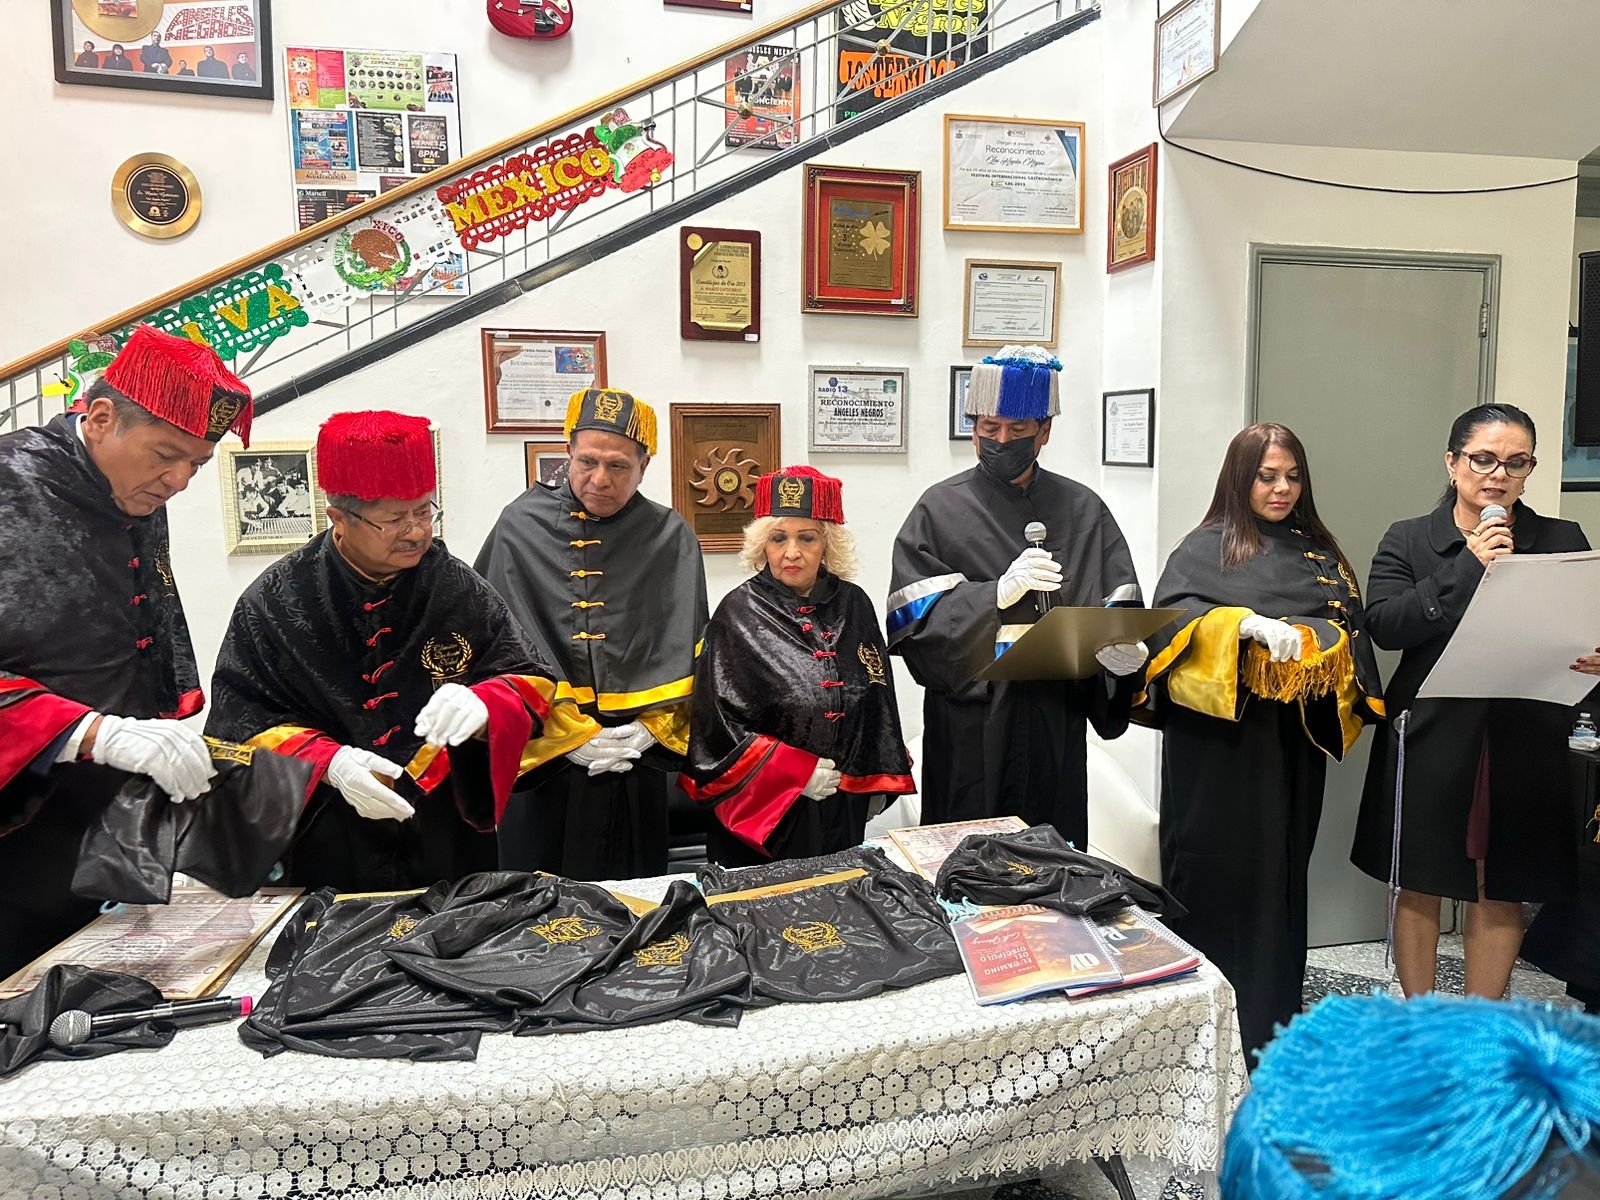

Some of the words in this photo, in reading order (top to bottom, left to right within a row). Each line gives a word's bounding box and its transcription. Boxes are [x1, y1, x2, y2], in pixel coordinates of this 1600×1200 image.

[166, 5, 254, 34] ANGELES
[985, 145, 1046, 156] Reconocimiento
[445, 147, 611, 232] MEXICO
[181, 284, 302, 348] IVA
[837, 385, 849, 393] 13
[820, 399, 895, 407] RECONOCIMIENTO
[833, 407, 859, 417] ANGELES
[860, 408, 884, 418] NEGROS
[1014, 951, 1029, 961] DEL
[984, 961, 1021, 976] CAMINO
